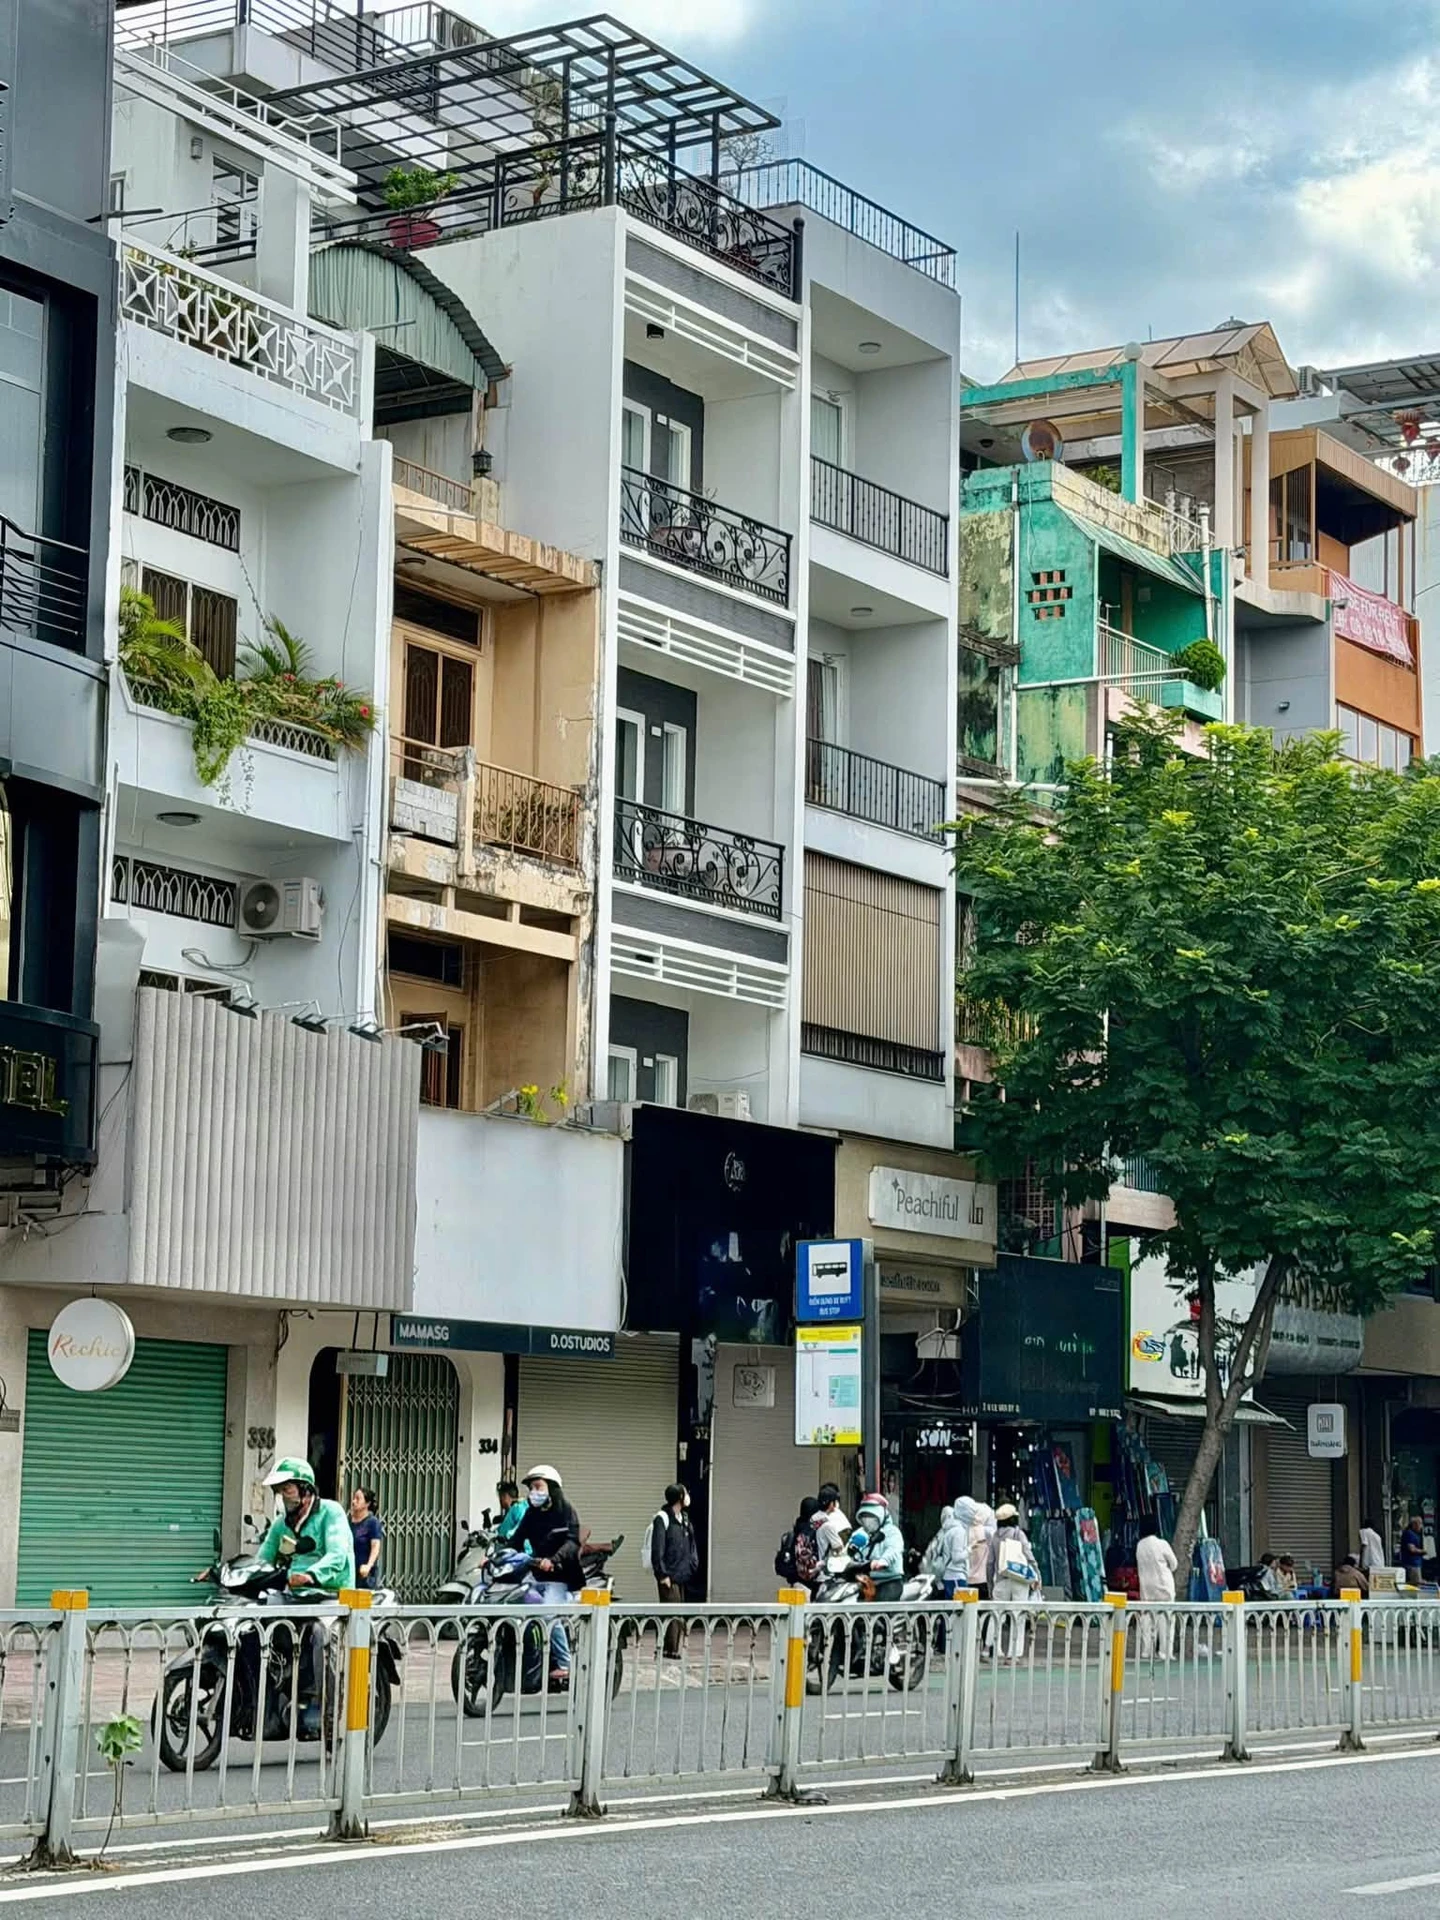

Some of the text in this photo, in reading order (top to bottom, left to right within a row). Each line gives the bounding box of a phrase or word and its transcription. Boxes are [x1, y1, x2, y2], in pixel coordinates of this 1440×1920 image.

[896, 1187, 959, 1222] Peachiful
[398, 1322, 450, 1341] MAMASG
[550, 1334, 610, 1353] D.OSTUDIOS
[478, 1438, 498, 1455] 334
